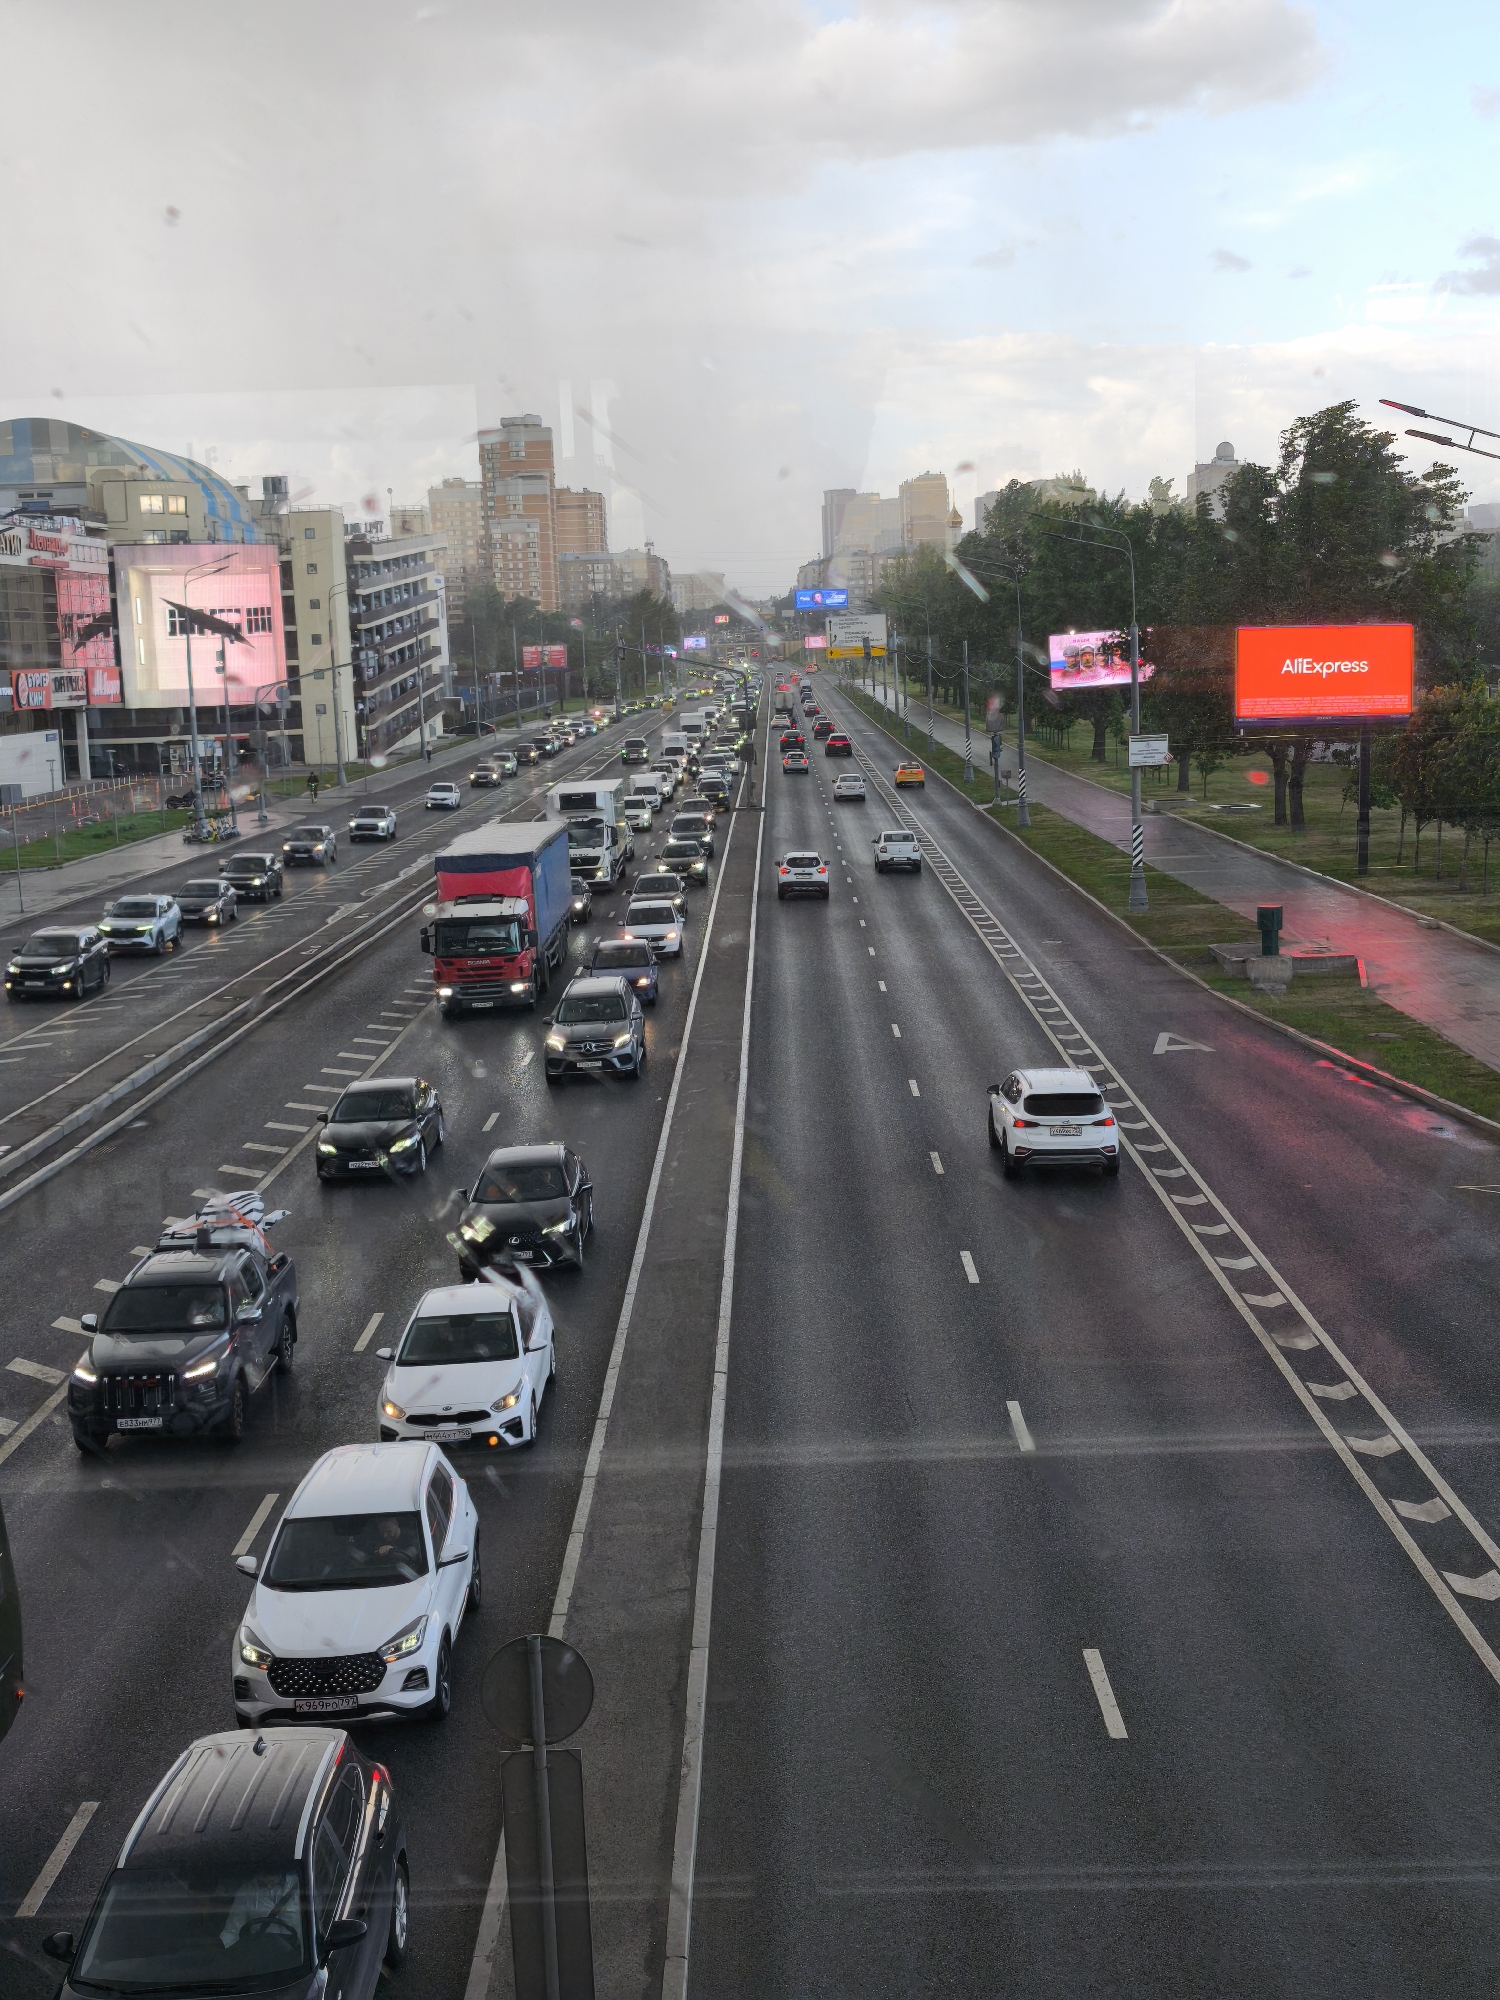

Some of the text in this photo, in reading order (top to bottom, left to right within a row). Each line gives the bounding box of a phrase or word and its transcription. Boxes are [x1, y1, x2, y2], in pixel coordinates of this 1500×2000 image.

[1281, 658, 1369, 678] AliExpress
[27, 672, 50, 688] БУРГЕР
[29, 691, 46, 706] КИНГ
